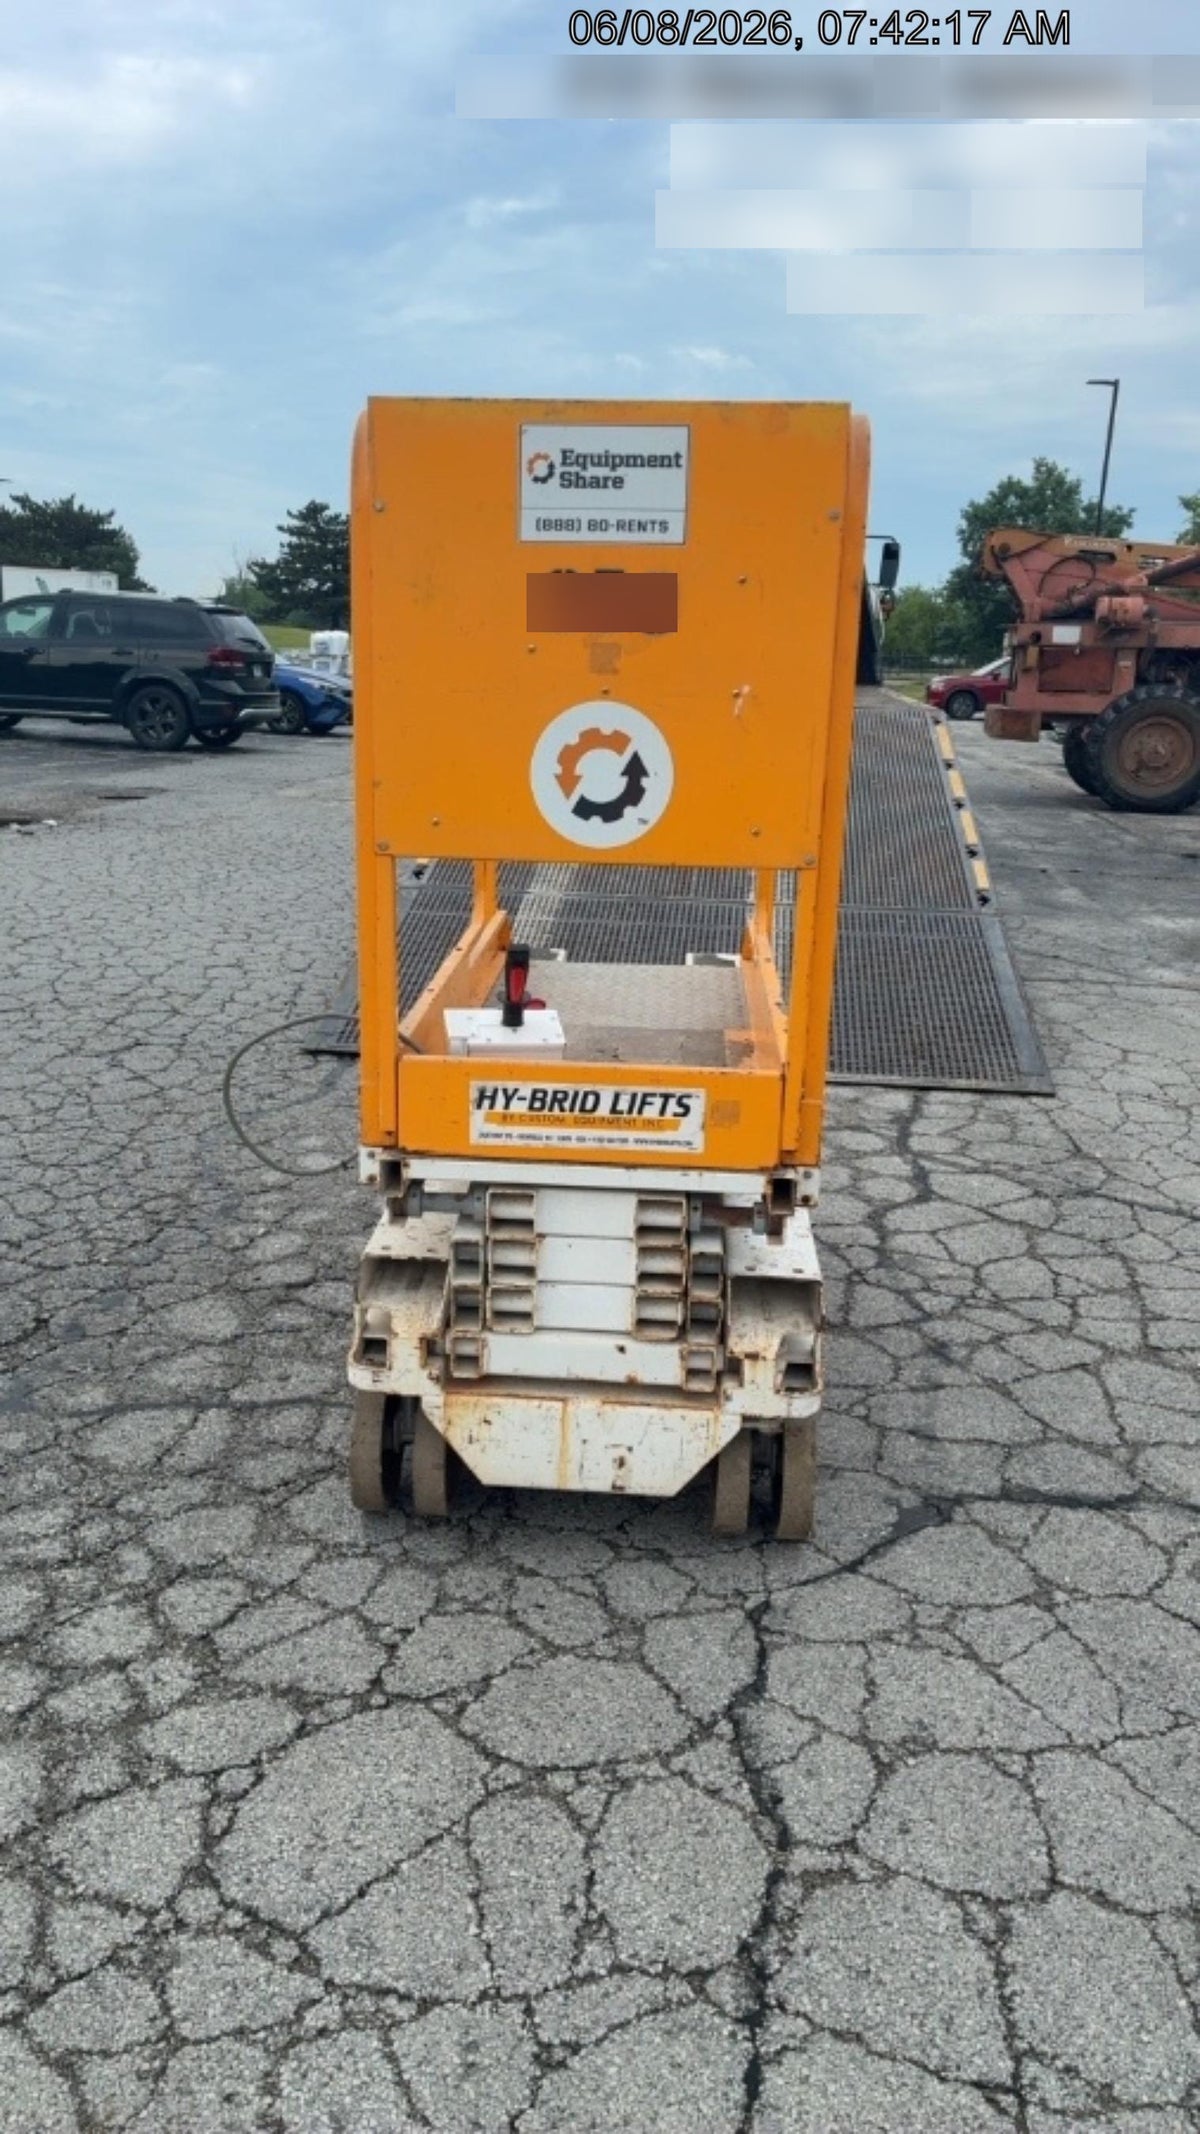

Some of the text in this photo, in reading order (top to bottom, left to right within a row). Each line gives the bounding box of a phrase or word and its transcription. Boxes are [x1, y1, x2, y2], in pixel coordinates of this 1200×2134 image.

[560, 449, 683, 471] Equipment
[559, 471, 625, 490] Share
[535, 517, 669, 533] (888) 80-RENTS
[475, 1087, 693, 1118] HY-BRID LIFTS
